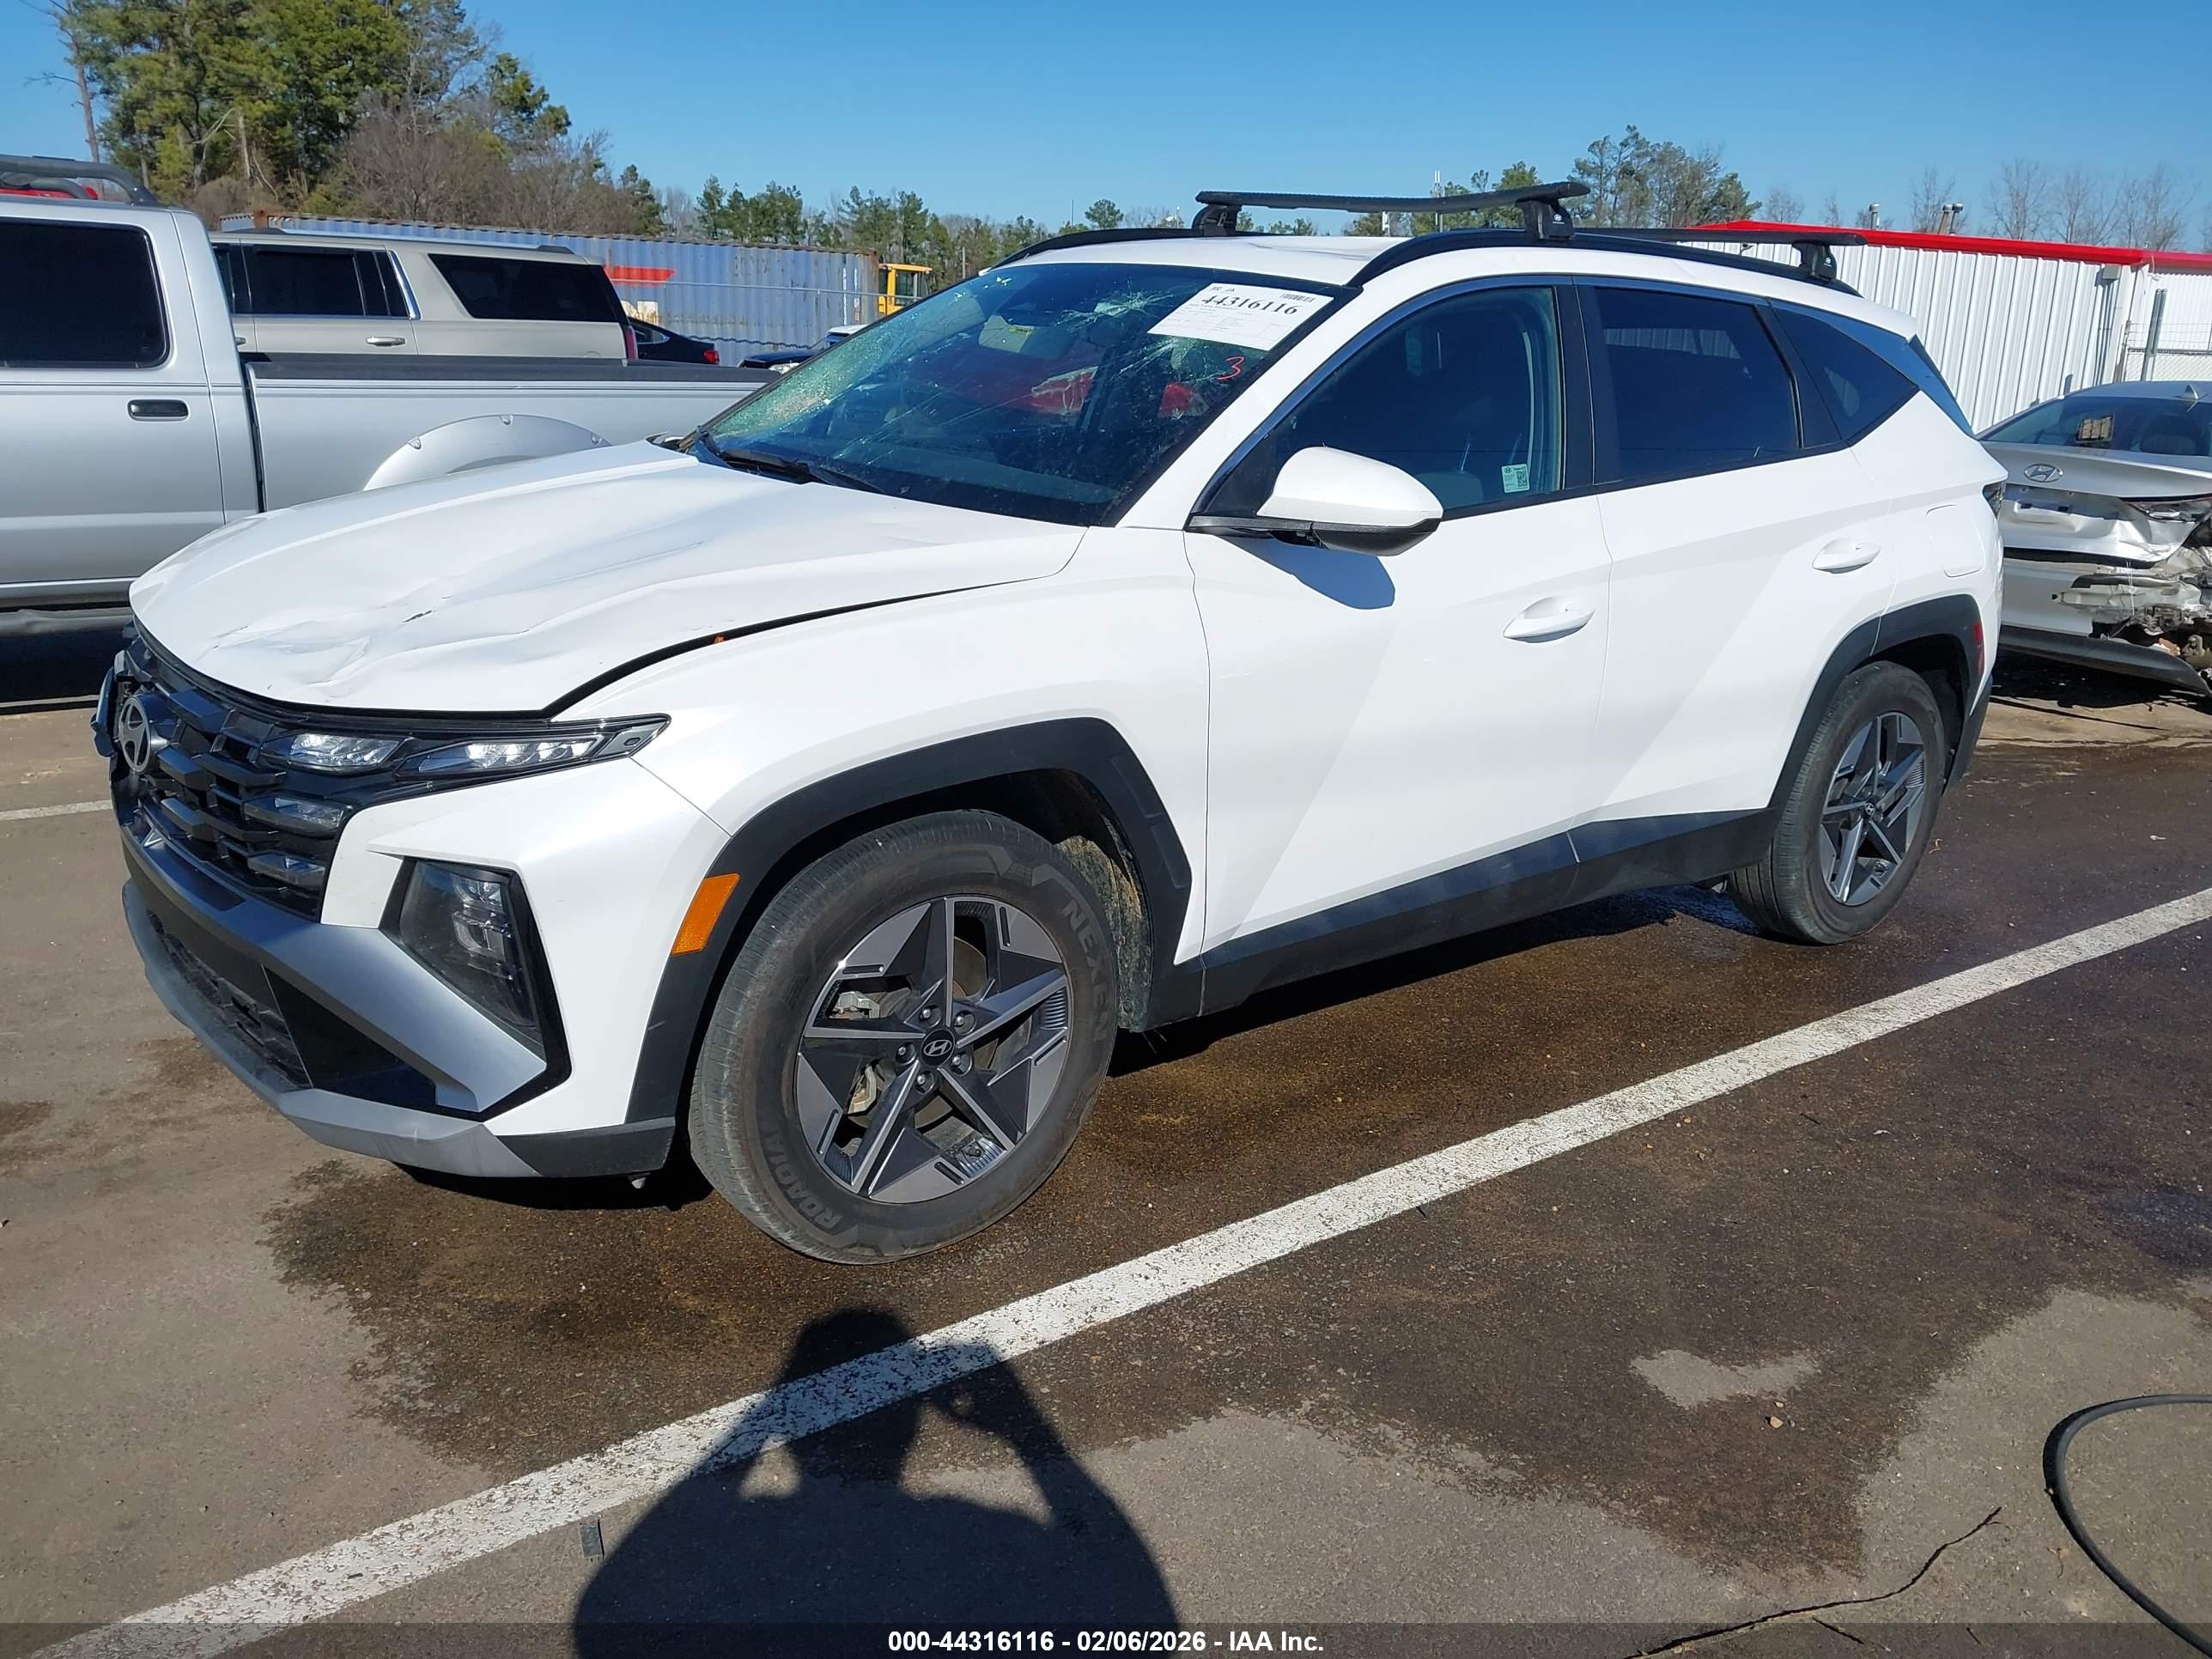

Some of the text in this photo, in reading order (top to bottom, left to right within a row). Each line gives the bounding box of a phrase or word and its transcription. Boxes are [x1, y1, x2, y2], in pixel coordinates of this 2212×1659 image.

[1202, 295, 1304, 315] 44316116
[1217, 356, 1244, 380] 3
[1060, 897, 1109, 1042] NEXEN
